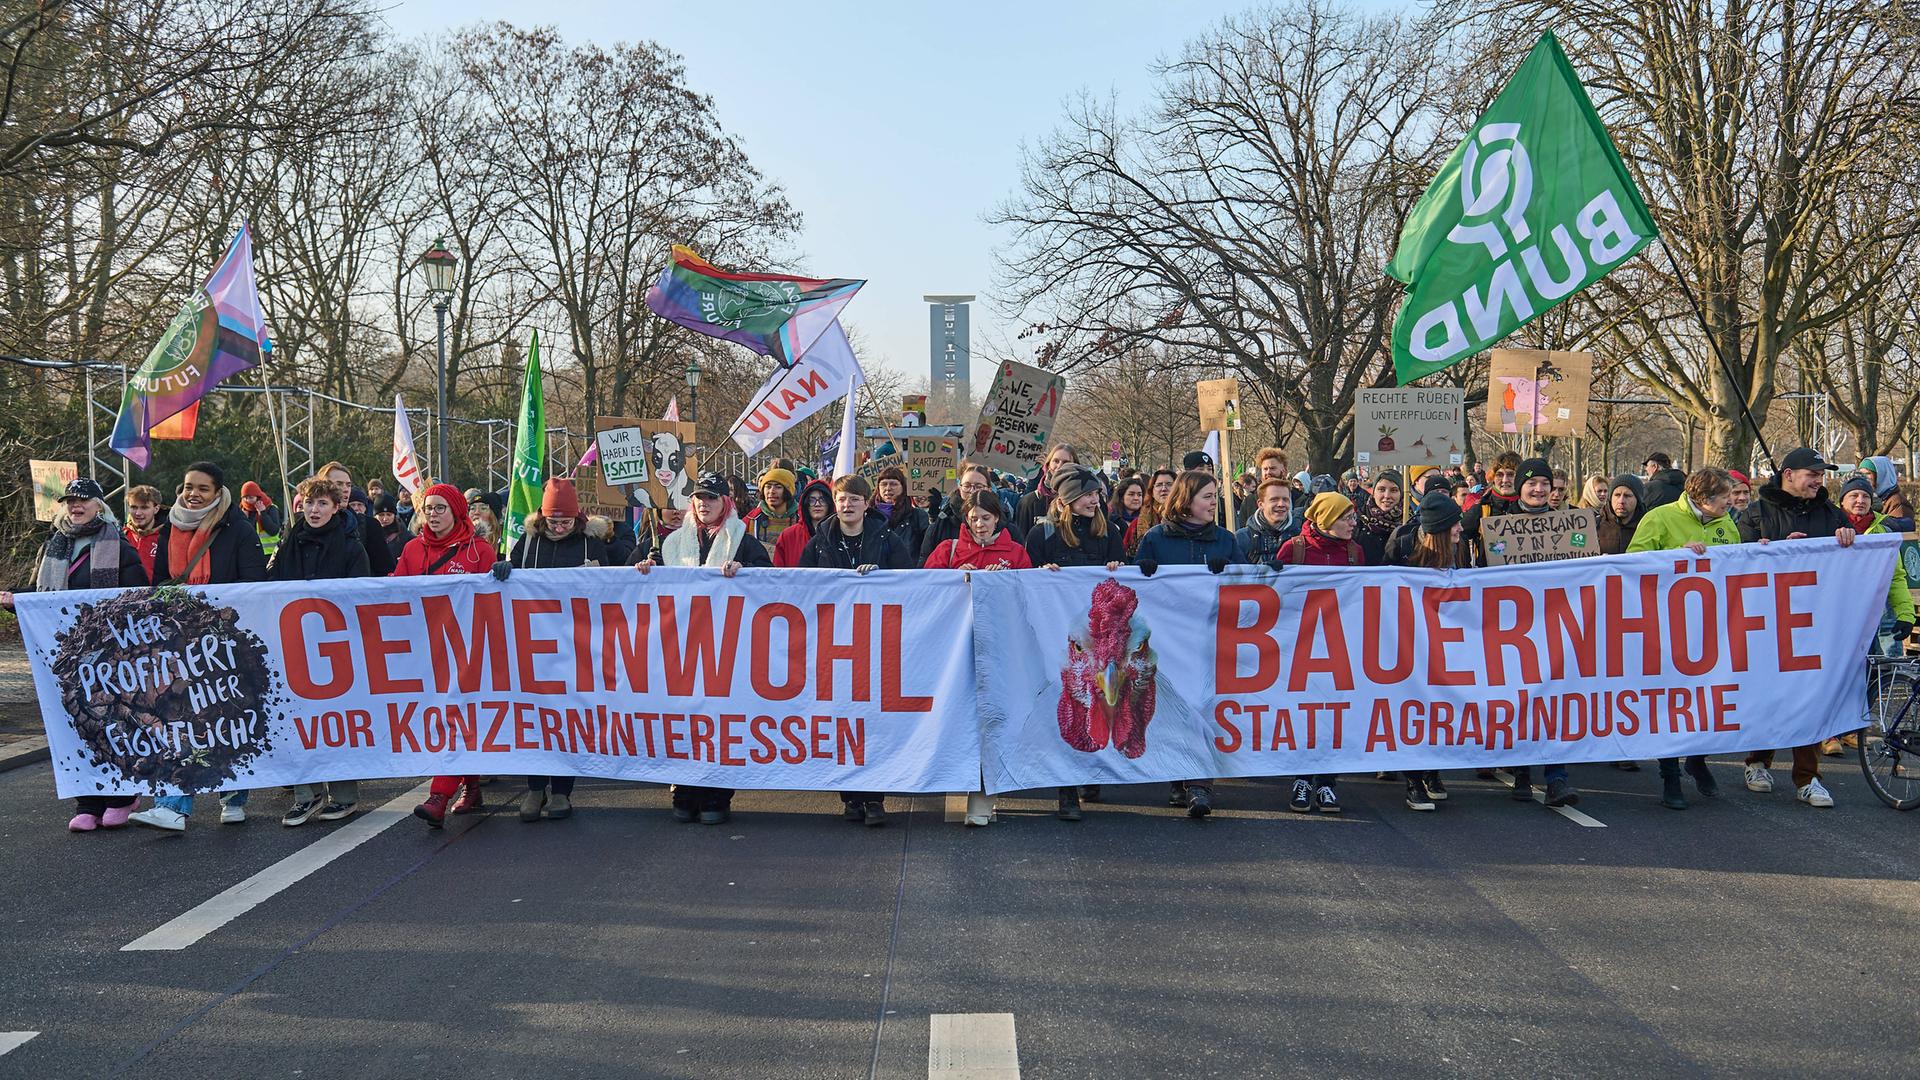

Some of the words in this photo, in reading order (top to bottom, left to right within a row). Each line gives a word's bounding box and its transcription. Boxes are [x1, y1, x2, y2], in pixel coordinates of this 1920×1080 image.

[1011, 380, 1032, 398] WE
[1362, 392, 1408, 404] RECHTE
[1417, 391, 1459, 404] RÜBEN
[997, 397, 1026, 418] ALL
[994, 416, 1039, 434] DESERVE
[608, 431, 630, 444] WIR
[913, 440, 936, 453] BIO
[602, 447, 629, 460] HABEN
[631, 445, 641, 456] ES
[912, 457, 954, 468] KARTOFFEL
[923, 470, 940, 478] AUF
[912, 481, 925, 491] DIE
[937, 476, 947, 494] 1
[1499, 514, 1588, 536] ACKERLAND
[1530, 535, 1545, 551] IN
[106, 613, 167, 650] WER
[1215, 558, 1821, 695] BAUERNHÖFE
[279, 591, 934, 713] GEMEINWOHL
[1214, 700, 1350, 753] STATT
[1365, 684, 1741, 752] AGRARINDUSTRIE
[294, 709, 375, 749] VOR
[387, 701, 865, 767] KONZERNINTERESSEN
